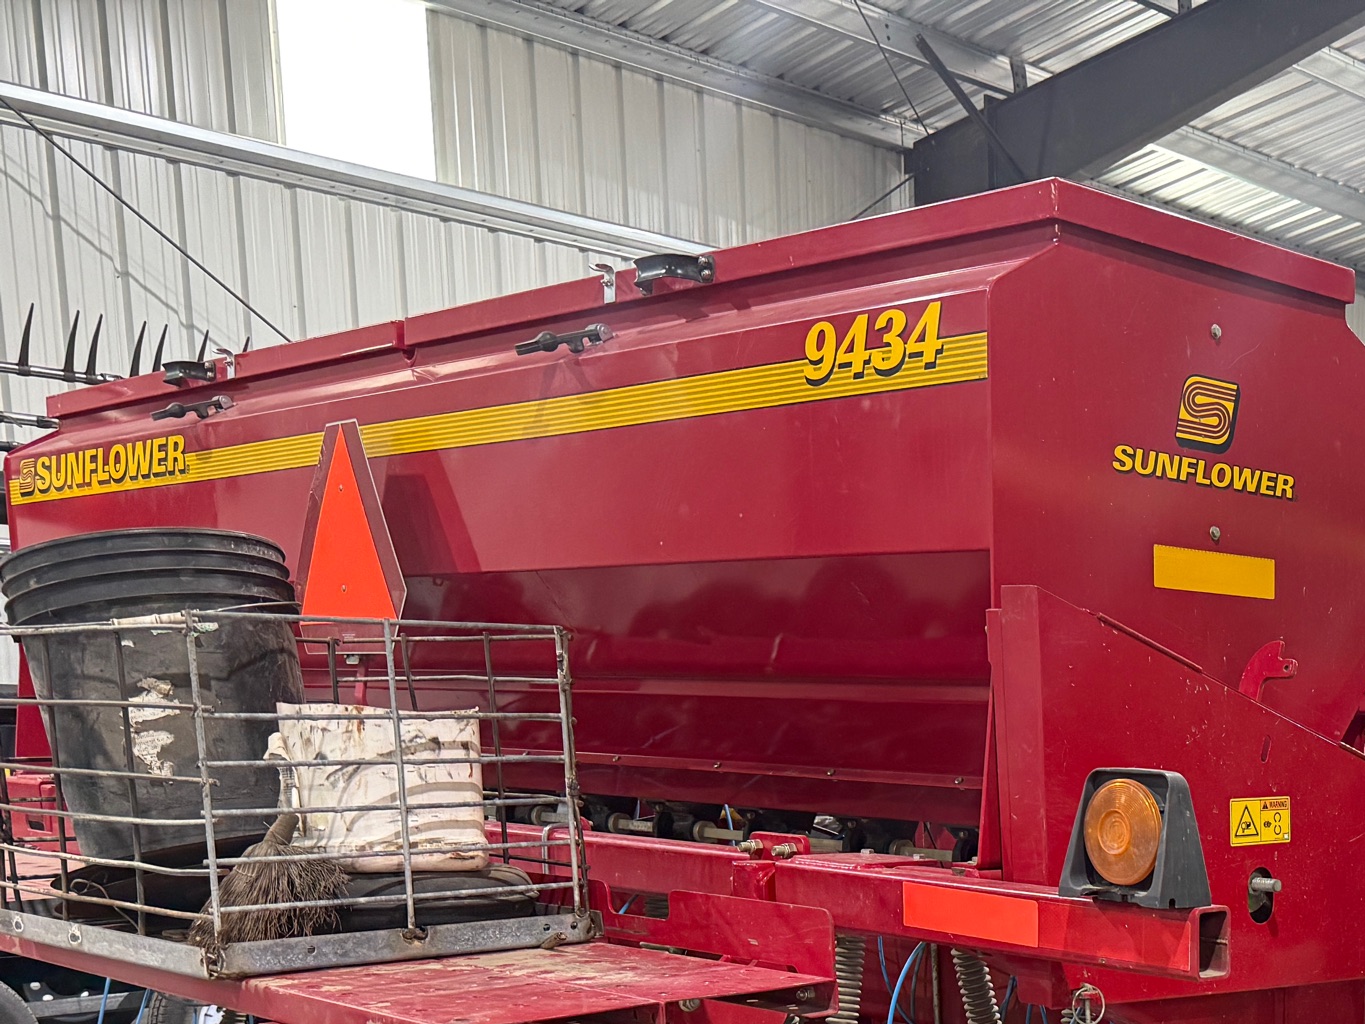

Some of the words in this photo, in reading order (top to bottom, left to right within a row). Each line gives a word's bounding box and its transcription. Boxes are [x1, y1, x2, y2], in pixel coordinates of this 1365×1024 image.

[804, 301, 944, 387] 9434
[36, 434, 187, 493] SUNFLOWER
[1112, 444, 1296, 501] SUNFLOWER
[1269, 800, 1288, 809] WARNING
